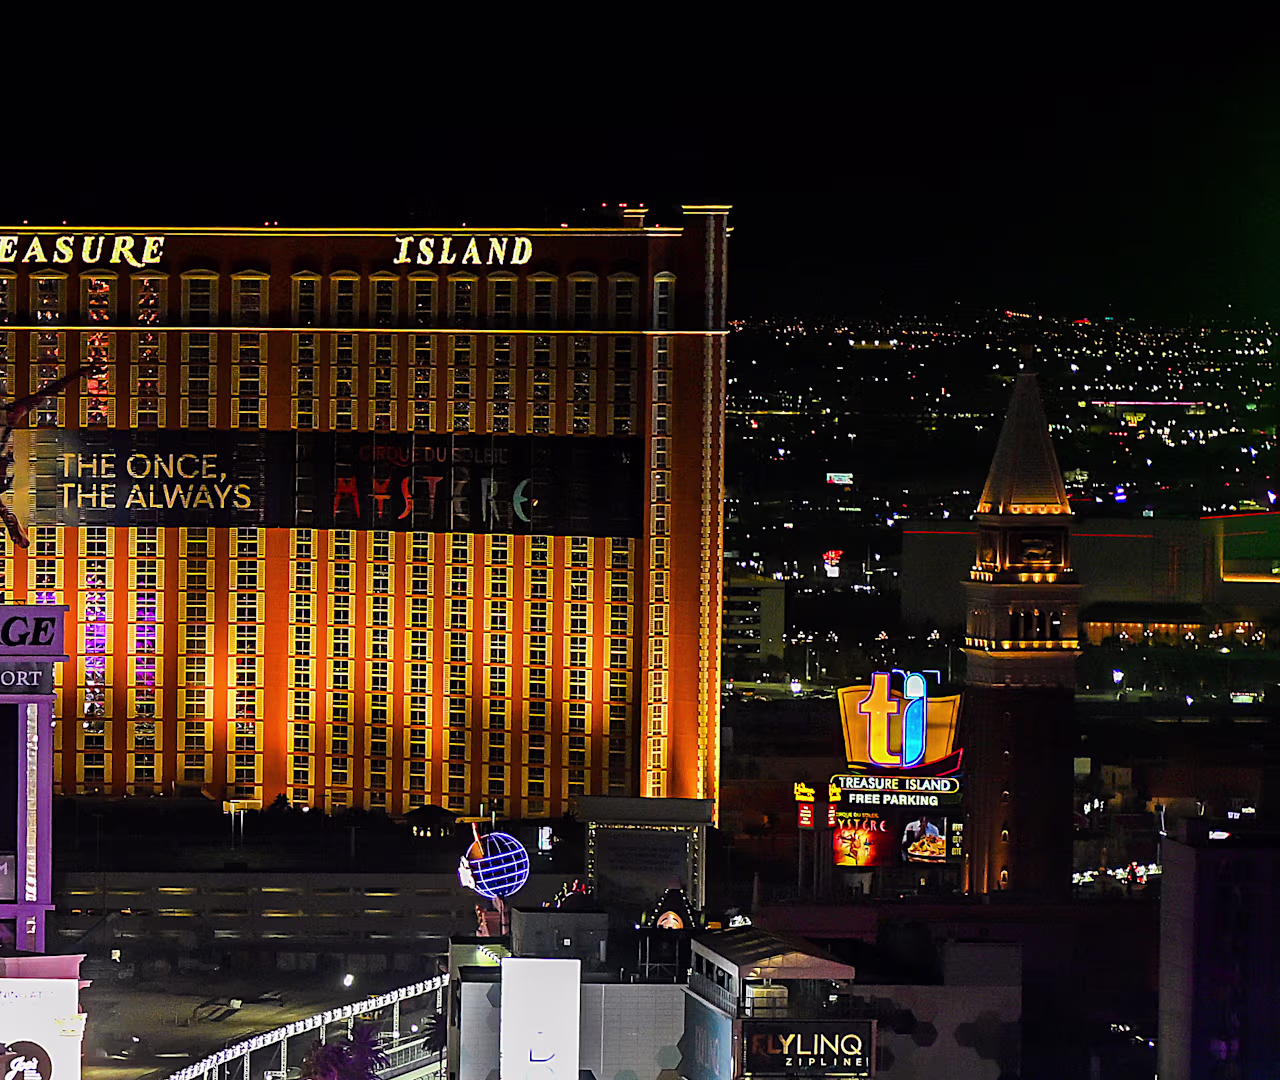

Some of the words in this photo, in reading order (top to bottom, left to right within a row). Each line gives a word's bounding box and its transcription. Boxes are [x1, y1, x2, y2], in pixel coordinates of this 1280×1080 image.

[392, 236, 533, 266] ISLAND
[62, 453, 116, 478] THE
[126, 453, 227, 483] ONCE,
[61, 483, 116, 508] THE
[125, 483, 252, 508] ALWAYS
[839, 776, 899, 790] TREASURE
[905, 777, 951, 791] ISLAND
[849, 793, 881, 805] FREE
[882, 793, 939, 806] PARKING
[785, 1057, 863, 1067] ZIPLINE
